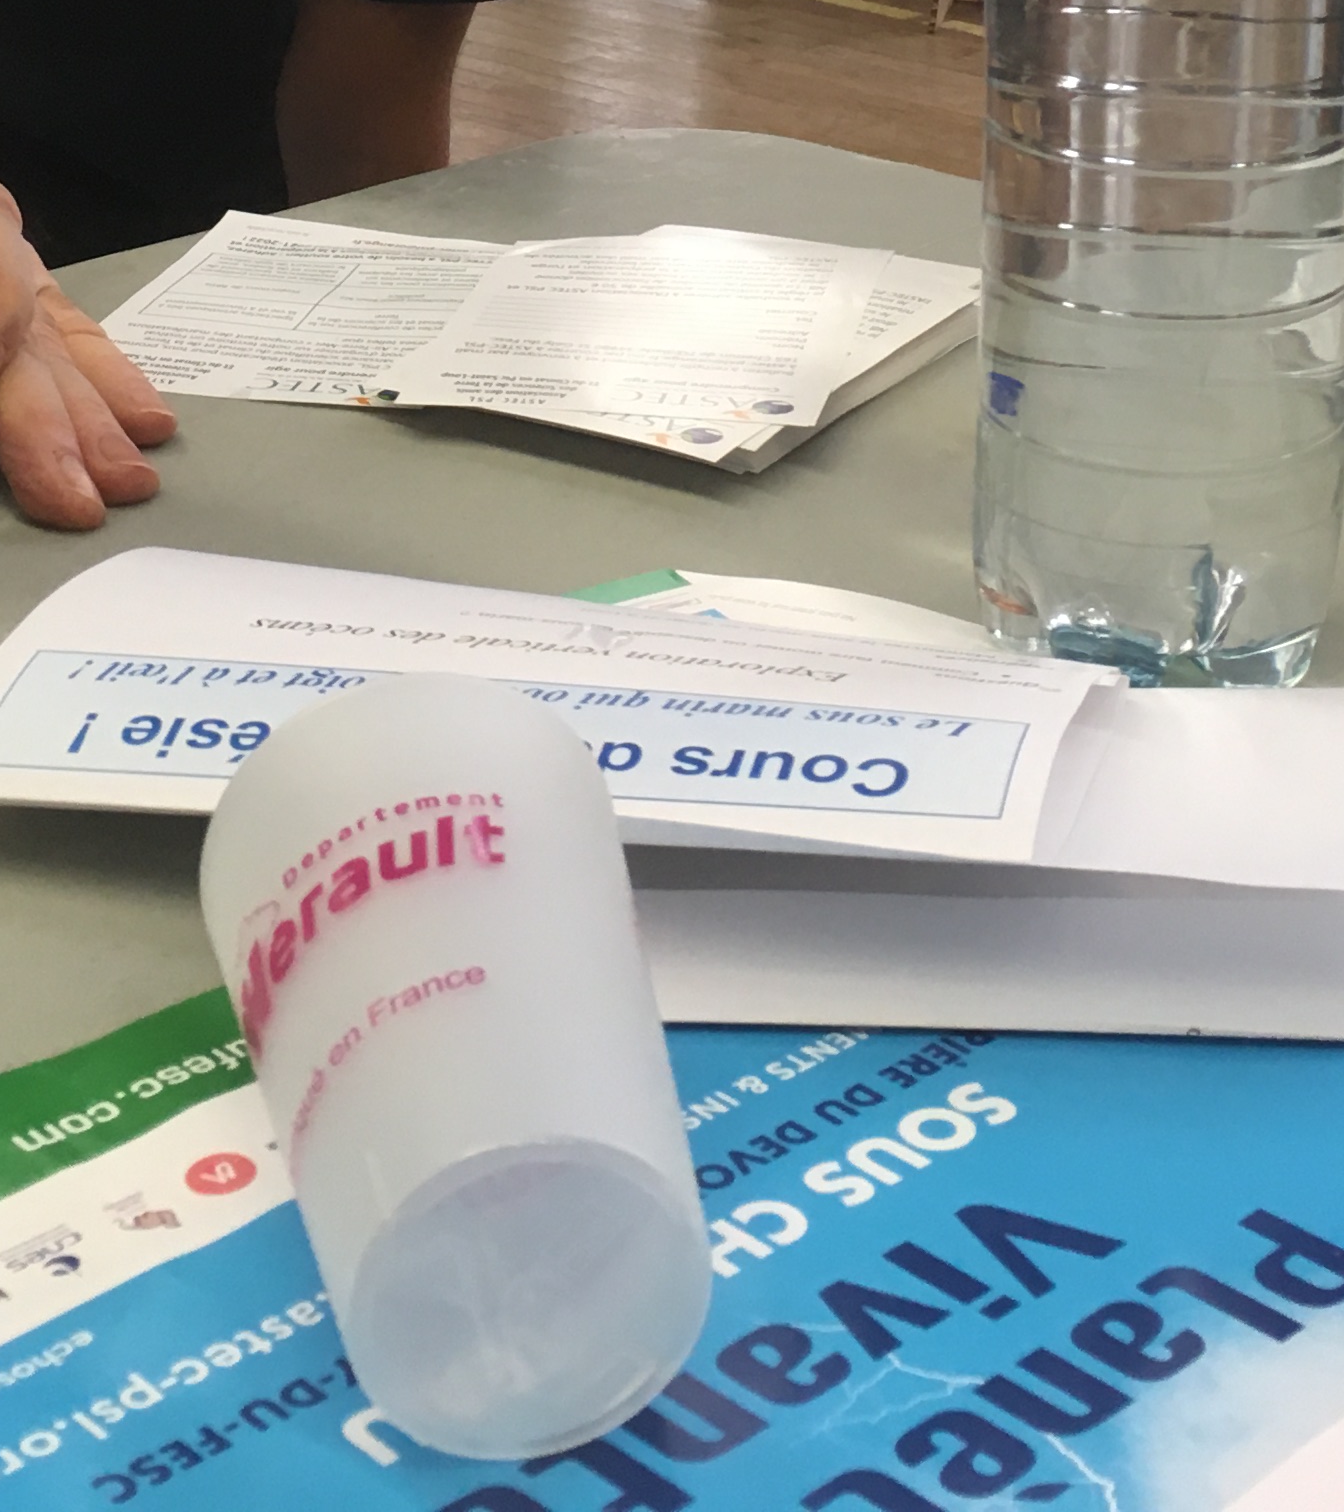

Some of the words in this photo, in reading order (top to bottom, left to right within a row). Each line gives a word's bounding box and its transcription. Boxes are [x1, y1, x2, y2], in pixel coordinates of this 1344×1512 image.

[250, 615, 376, 639] océans
[383, 624, 446, 644] des
[452, 633, 613, 658] verticale
[625, 646, 849, 686] Exploration
[283, 666, 366, 695] oigt
[664, 696, 792, 721] marin
[805, 708, 907, 731] sous
[120, 713, 272, 763] ésie
[916, 713, 974, 738] Le
[670, 738, 910, 798] Cours
[814, 1082, 887, 1128] DU
[804, 1081, 1018, 1208] SOUS
